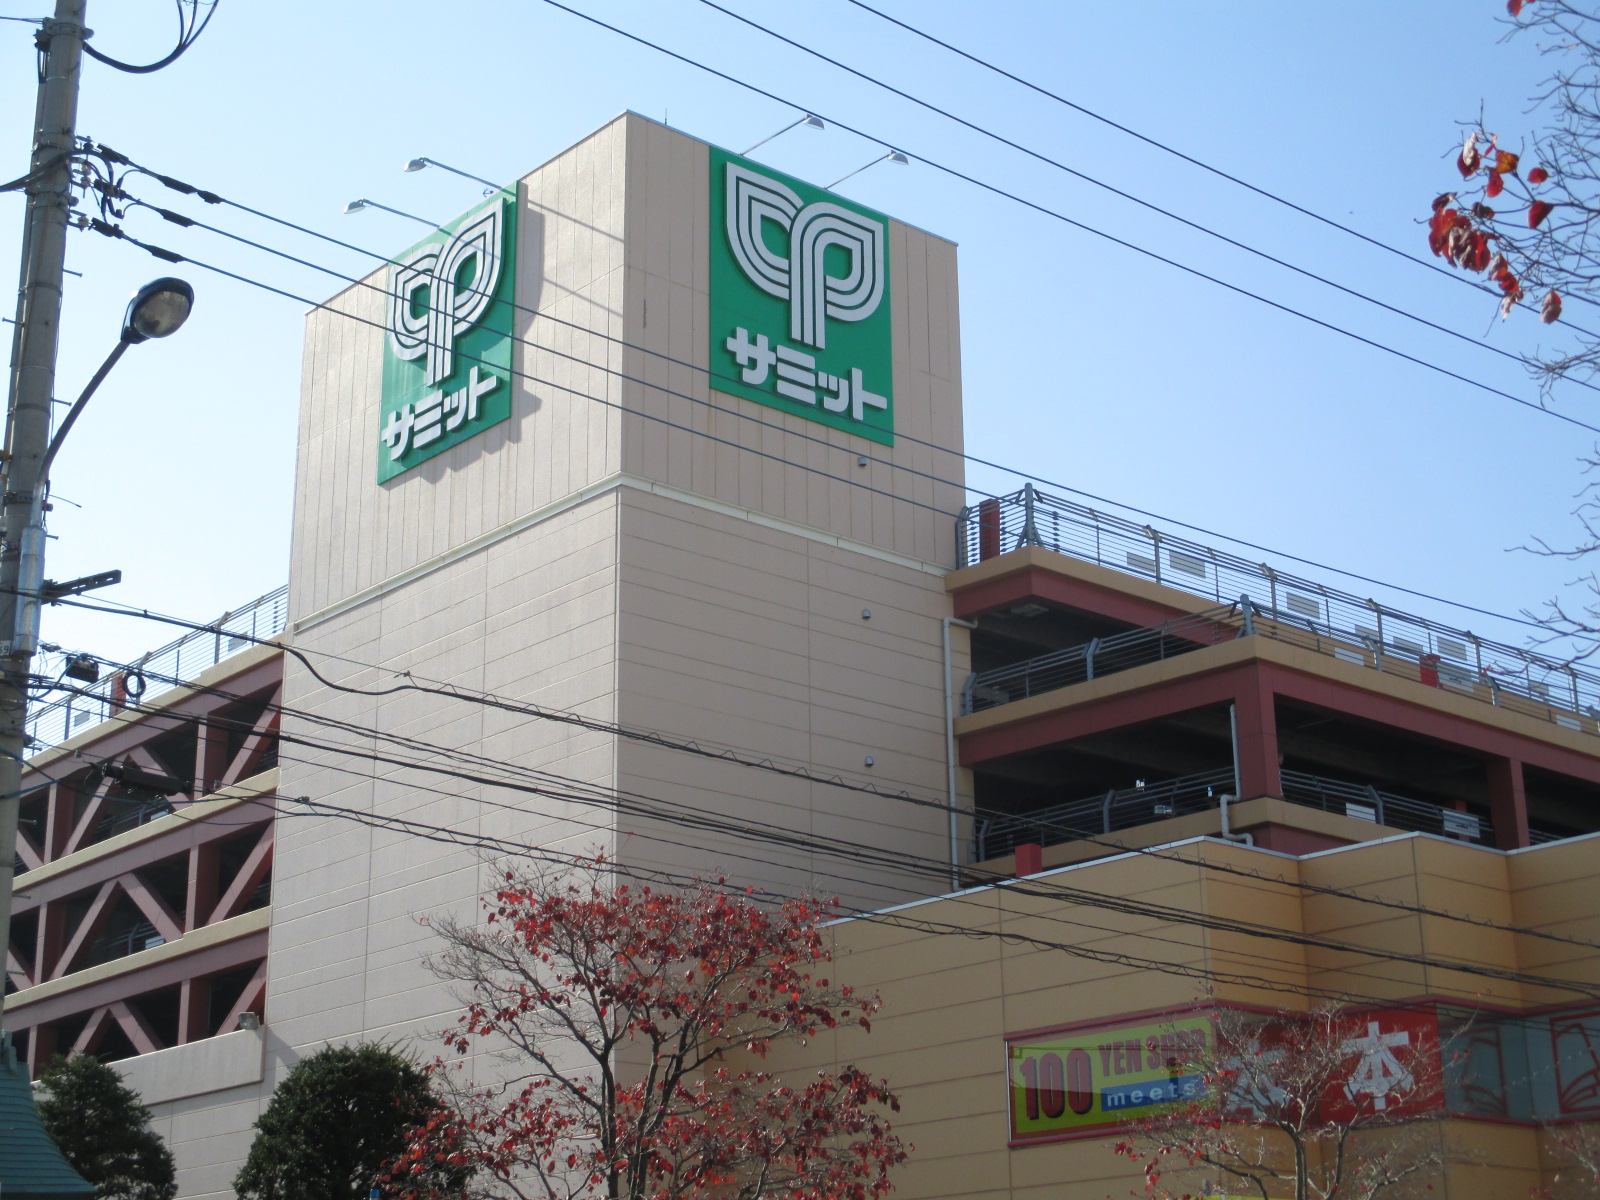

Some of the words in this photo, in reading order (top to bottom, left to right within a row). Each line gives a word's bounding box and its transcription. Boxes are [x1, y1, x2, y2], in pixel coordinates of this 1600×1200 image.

[381, 365, 497, 461] サミット
[725, 326, 888, 421] サミット
[1019, 1048, 1094, 1121] 100
[1097, 1038, 1143, 1077] YEN
[1106, 1082, 1197, 1108] meets
[1340, 1021, 1414, 1110] 本
